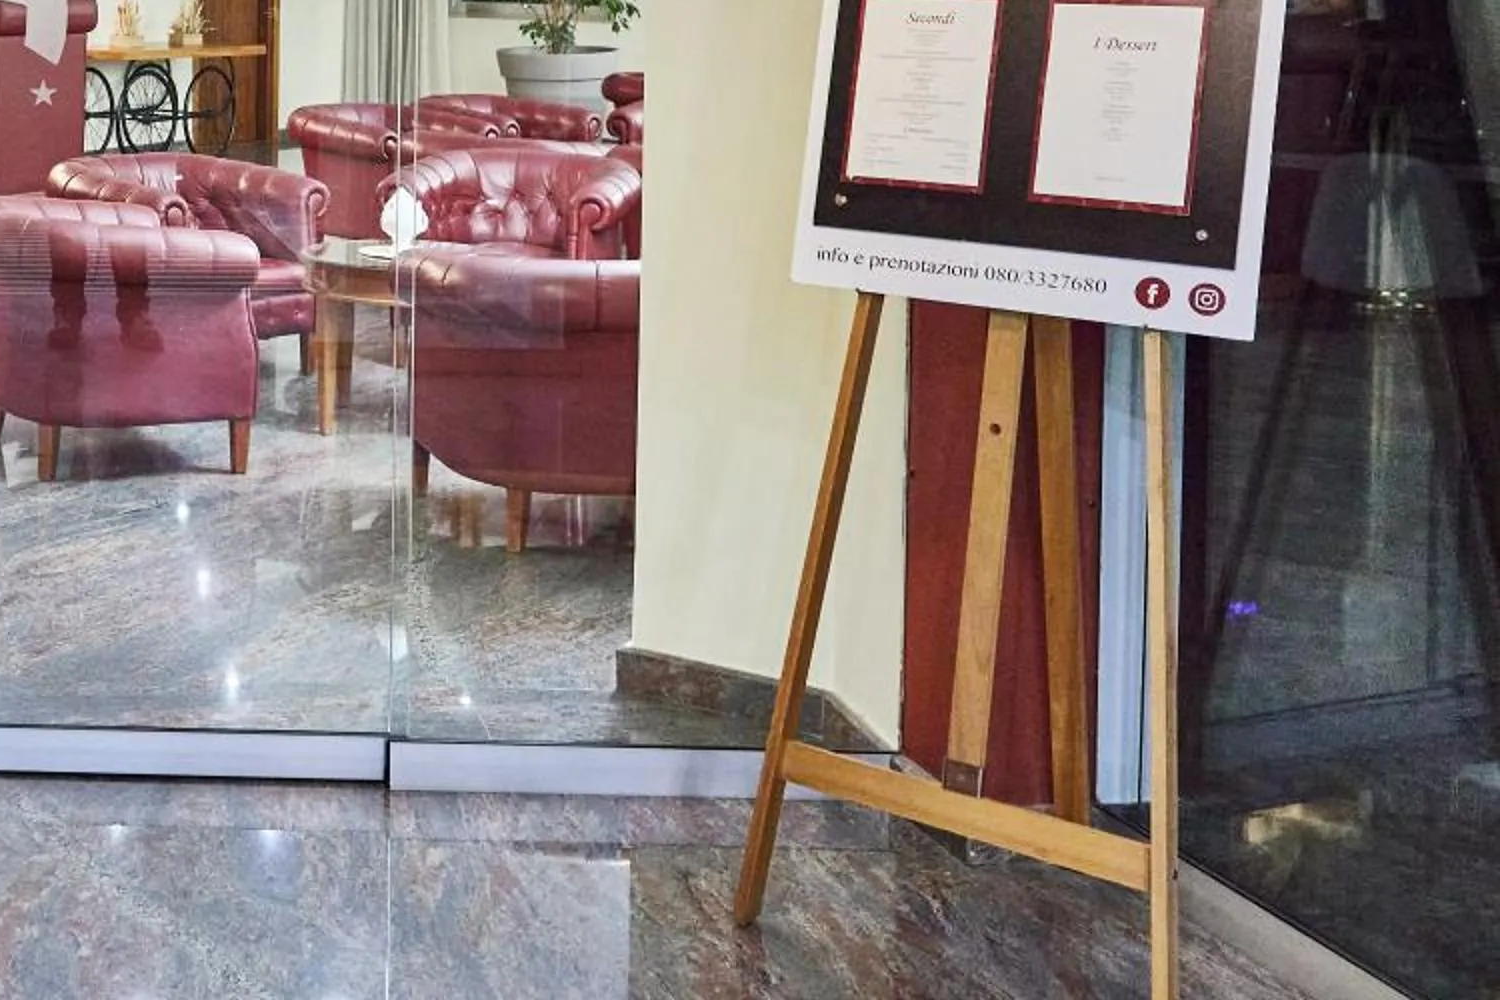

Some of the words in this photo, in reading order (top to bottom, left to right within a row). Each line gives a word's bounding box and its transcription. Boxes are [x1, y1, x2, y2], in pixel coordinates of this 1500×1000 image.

[816, 246, 850, 264] info
[854, 253, 865, 265] e
[869, 255, 980, 280] prenotazioni
